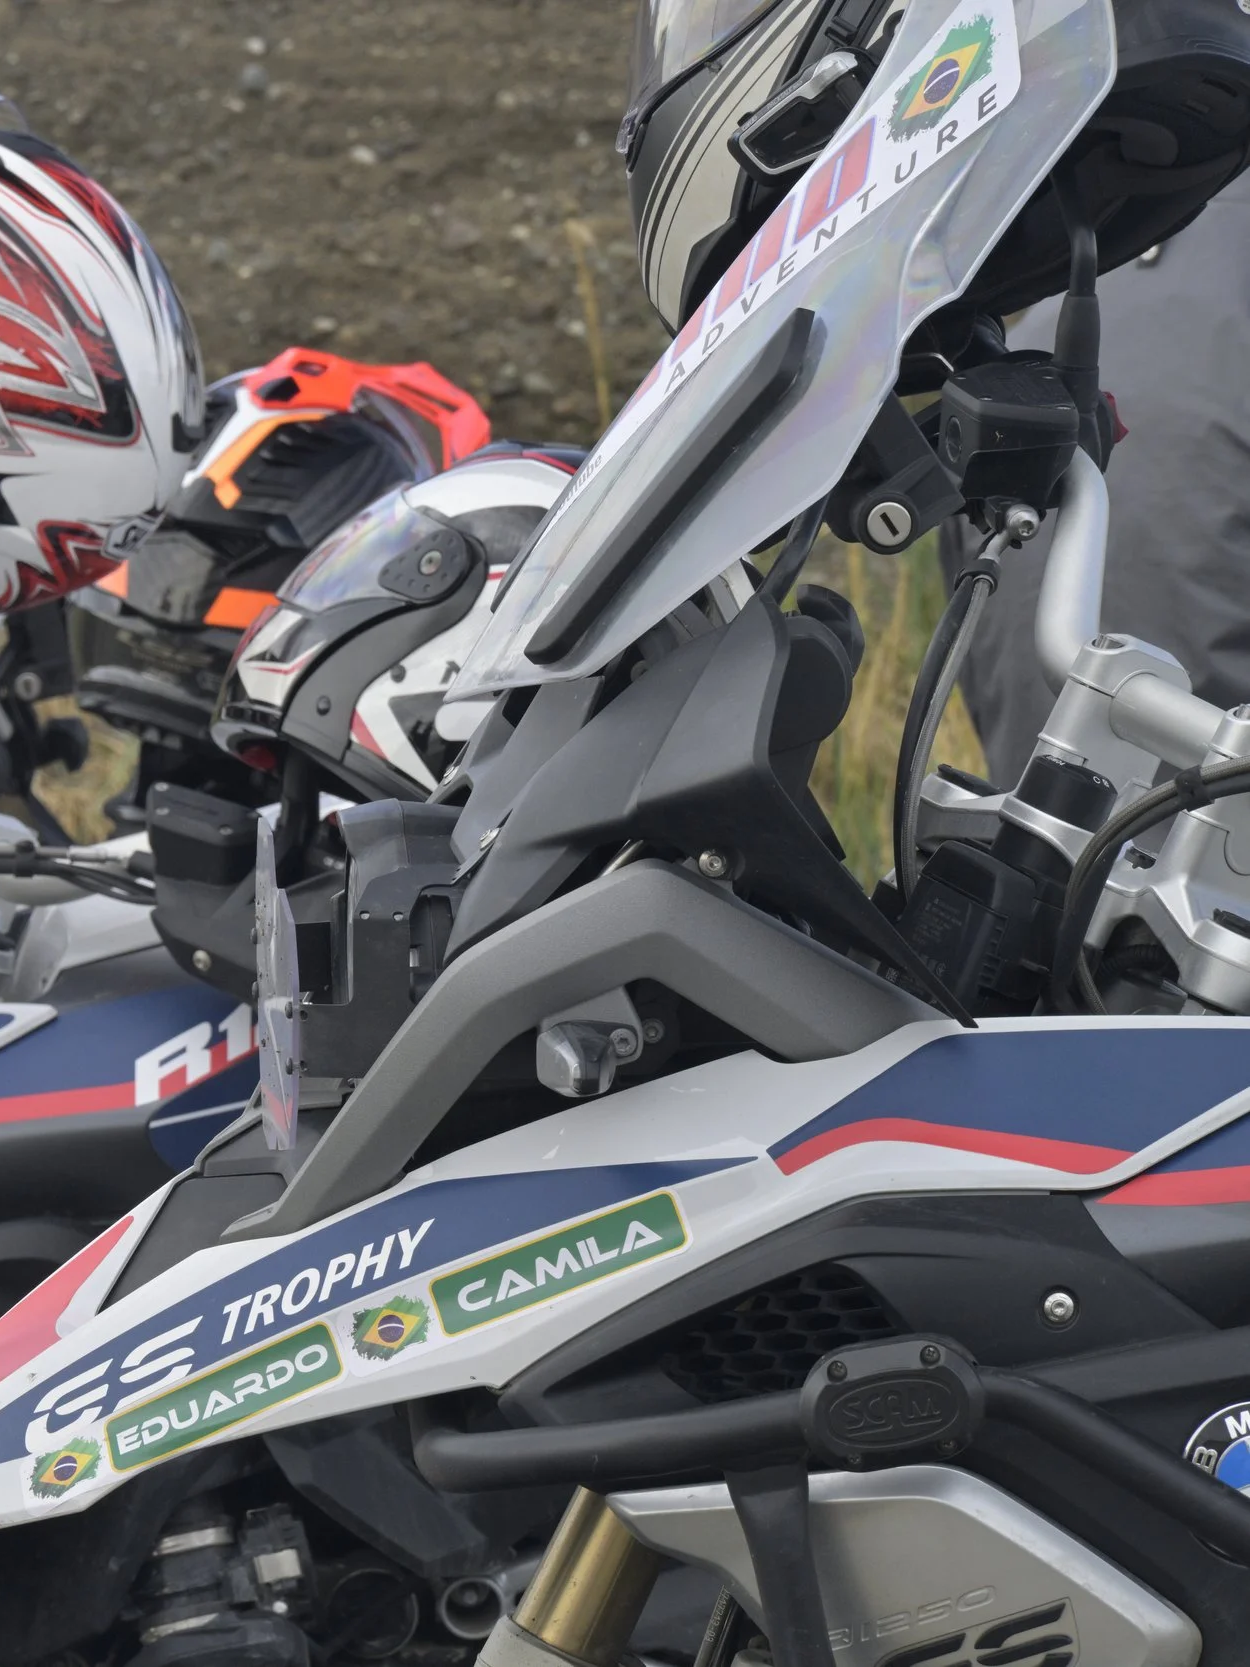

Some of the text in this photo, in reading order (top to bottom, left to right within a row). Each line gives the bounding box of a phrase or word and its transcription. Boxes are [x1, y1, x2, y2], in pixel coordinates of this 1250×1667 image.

[665, 83, 998, 395] ADVENTURE
[134, 1002, 259, 1107] R1
[457, 1220, 664, 1312] CAMILA
[24, 1217, 435, 1455] GS TROPHY
[115, 1343, 329, 1456] EDUARDO
